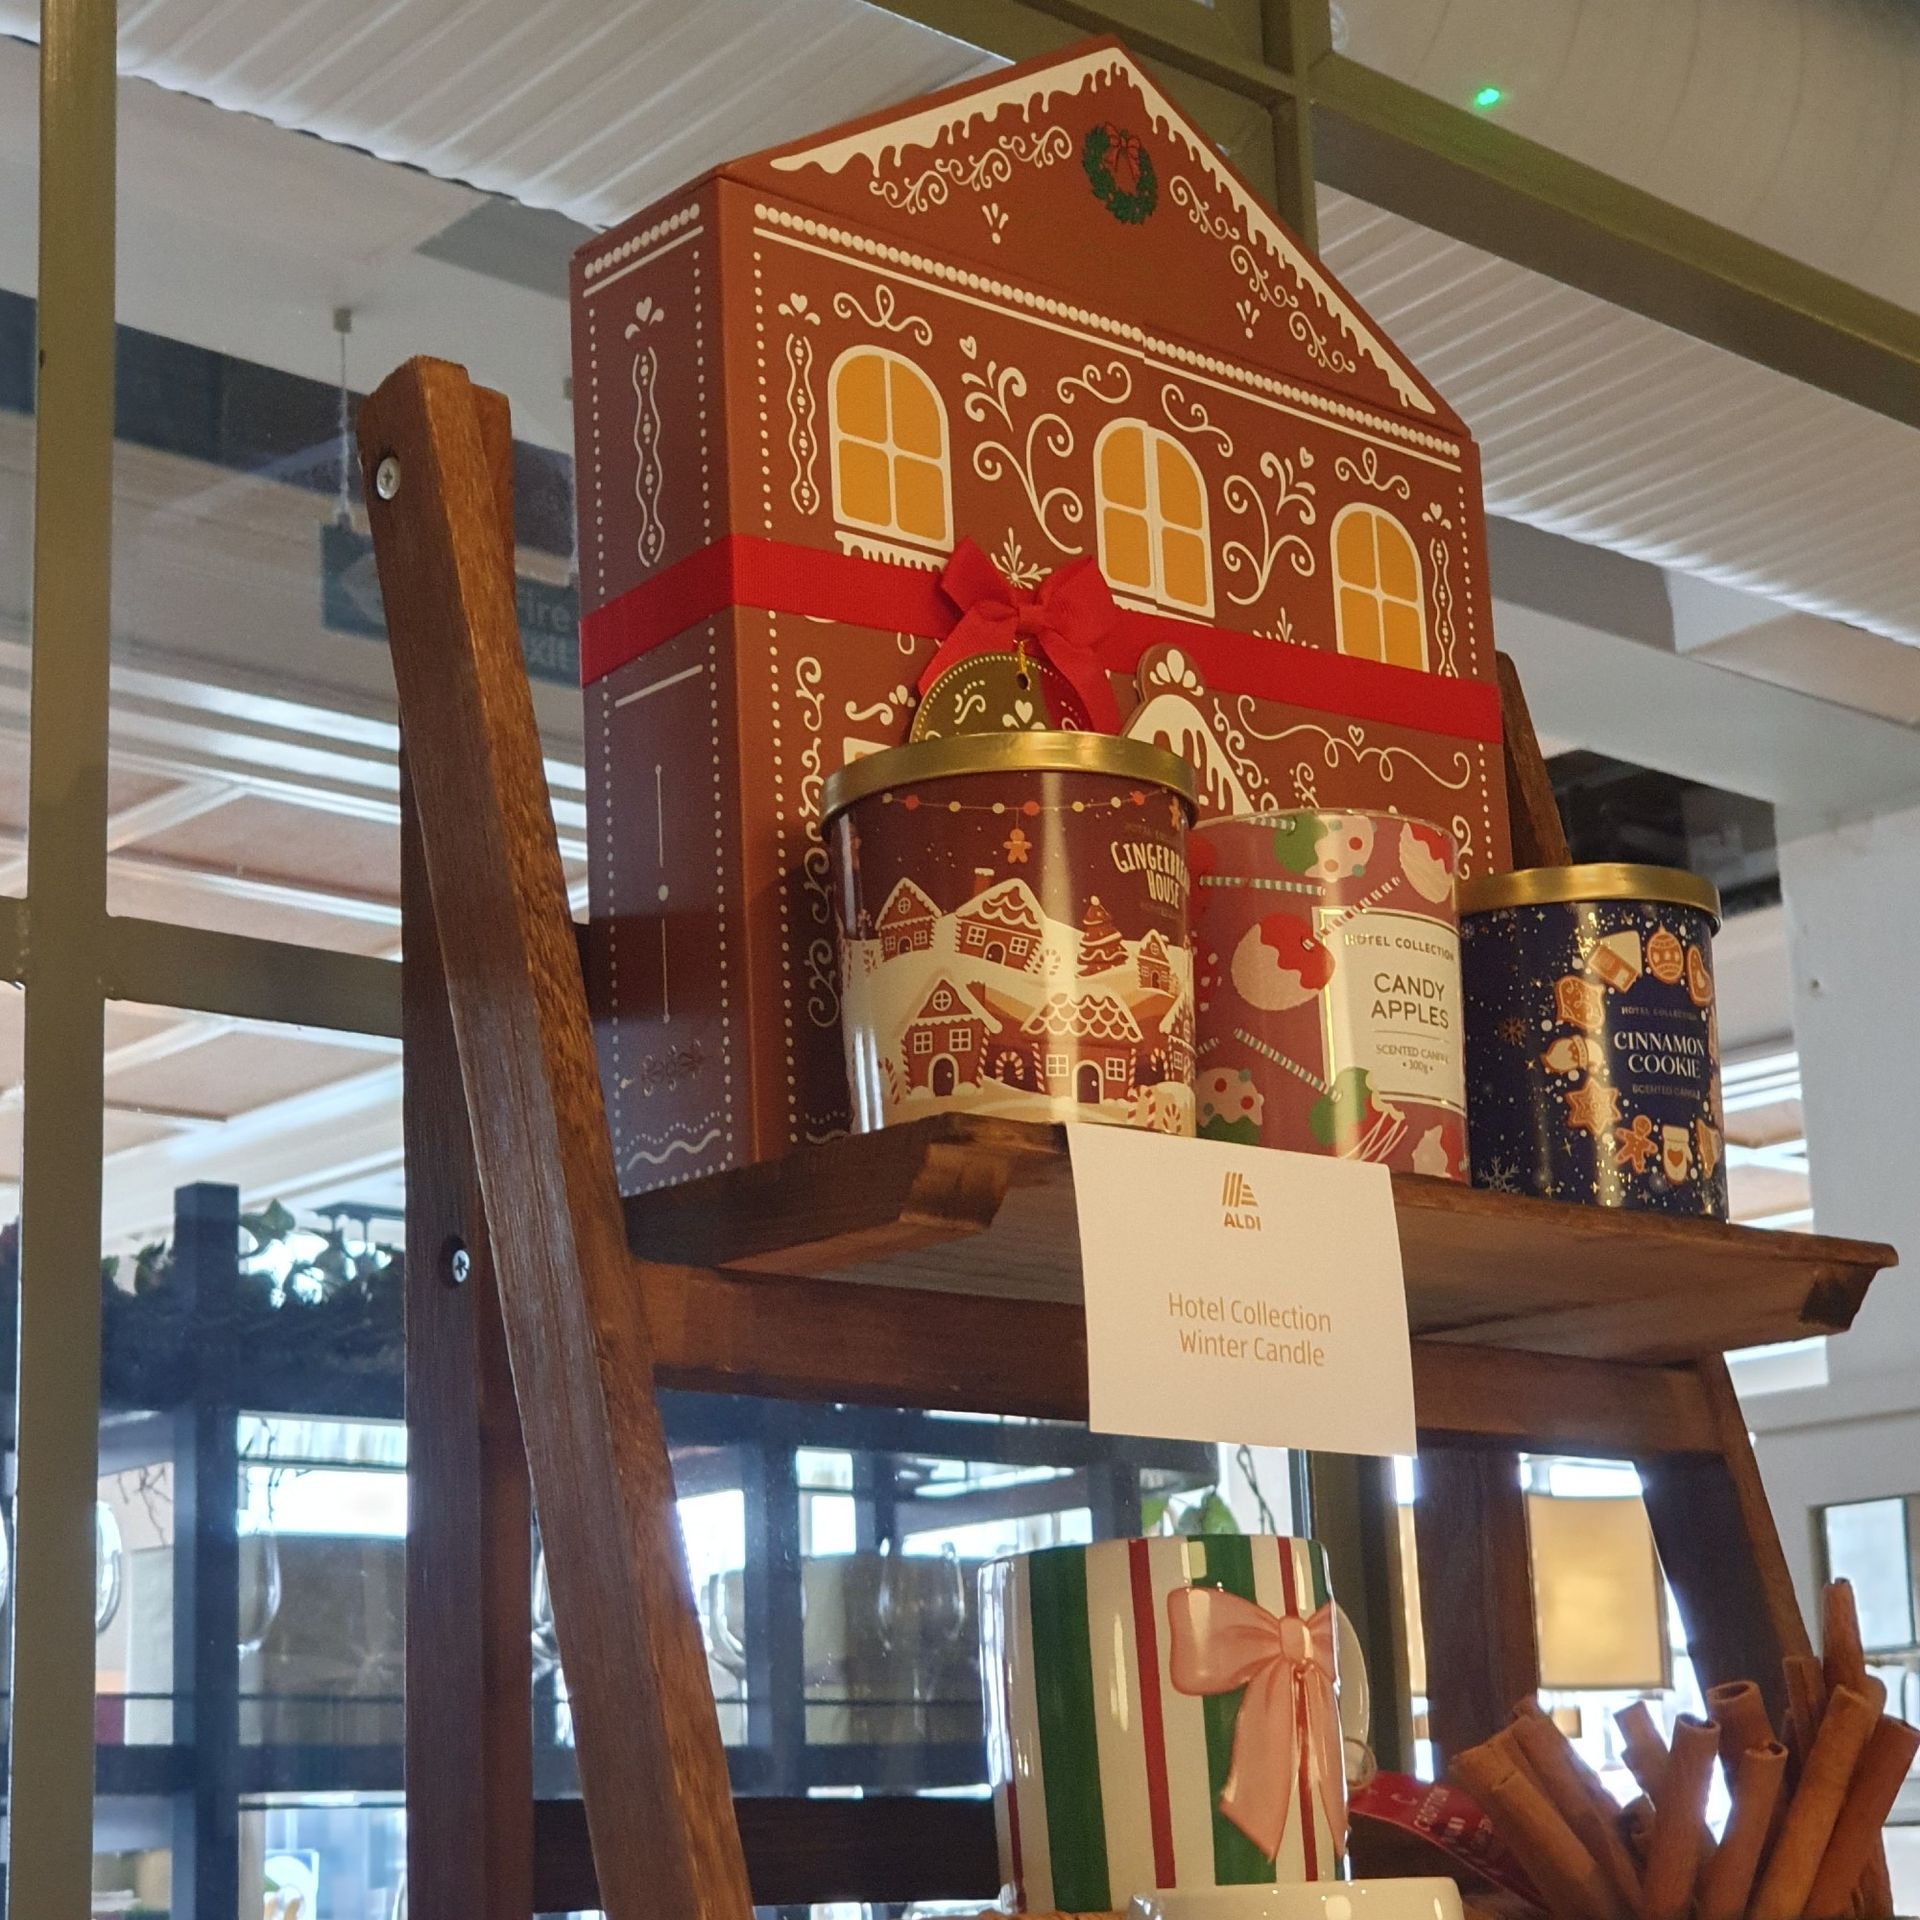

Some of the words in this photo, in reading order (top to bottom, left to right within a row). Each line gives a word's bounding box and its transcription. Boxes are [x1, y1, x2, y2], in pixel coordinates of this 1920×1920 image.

[517, 589, 570, 632] ire
[524, 635, 571, 672] xit
[1146, 869, 1180, 909] HOUSE
[1344, 933, 1390, 947] HOTEL
[1395, 937, 1456, 962] COLLECTION
[1373, 972, 1446, 1001] CANDY
[1370, 1000, 1450, 1030] APPLES
[1375, 1044, 1419, 1058] SCENTED
[1613, 1030, 1705, 1058] CINNAMON
[1628, 1053, 1701, 1079] COOKIE
[1223, 1212, 1262, 1231] ALDI
[1168, 1292, 1225, 1322] Hotel
[1230, 1300, 1332, 1333] Collection
[1179, 1329, 1248, 1359] Winter
[1253, 1337, 1326, 1367] Candle
